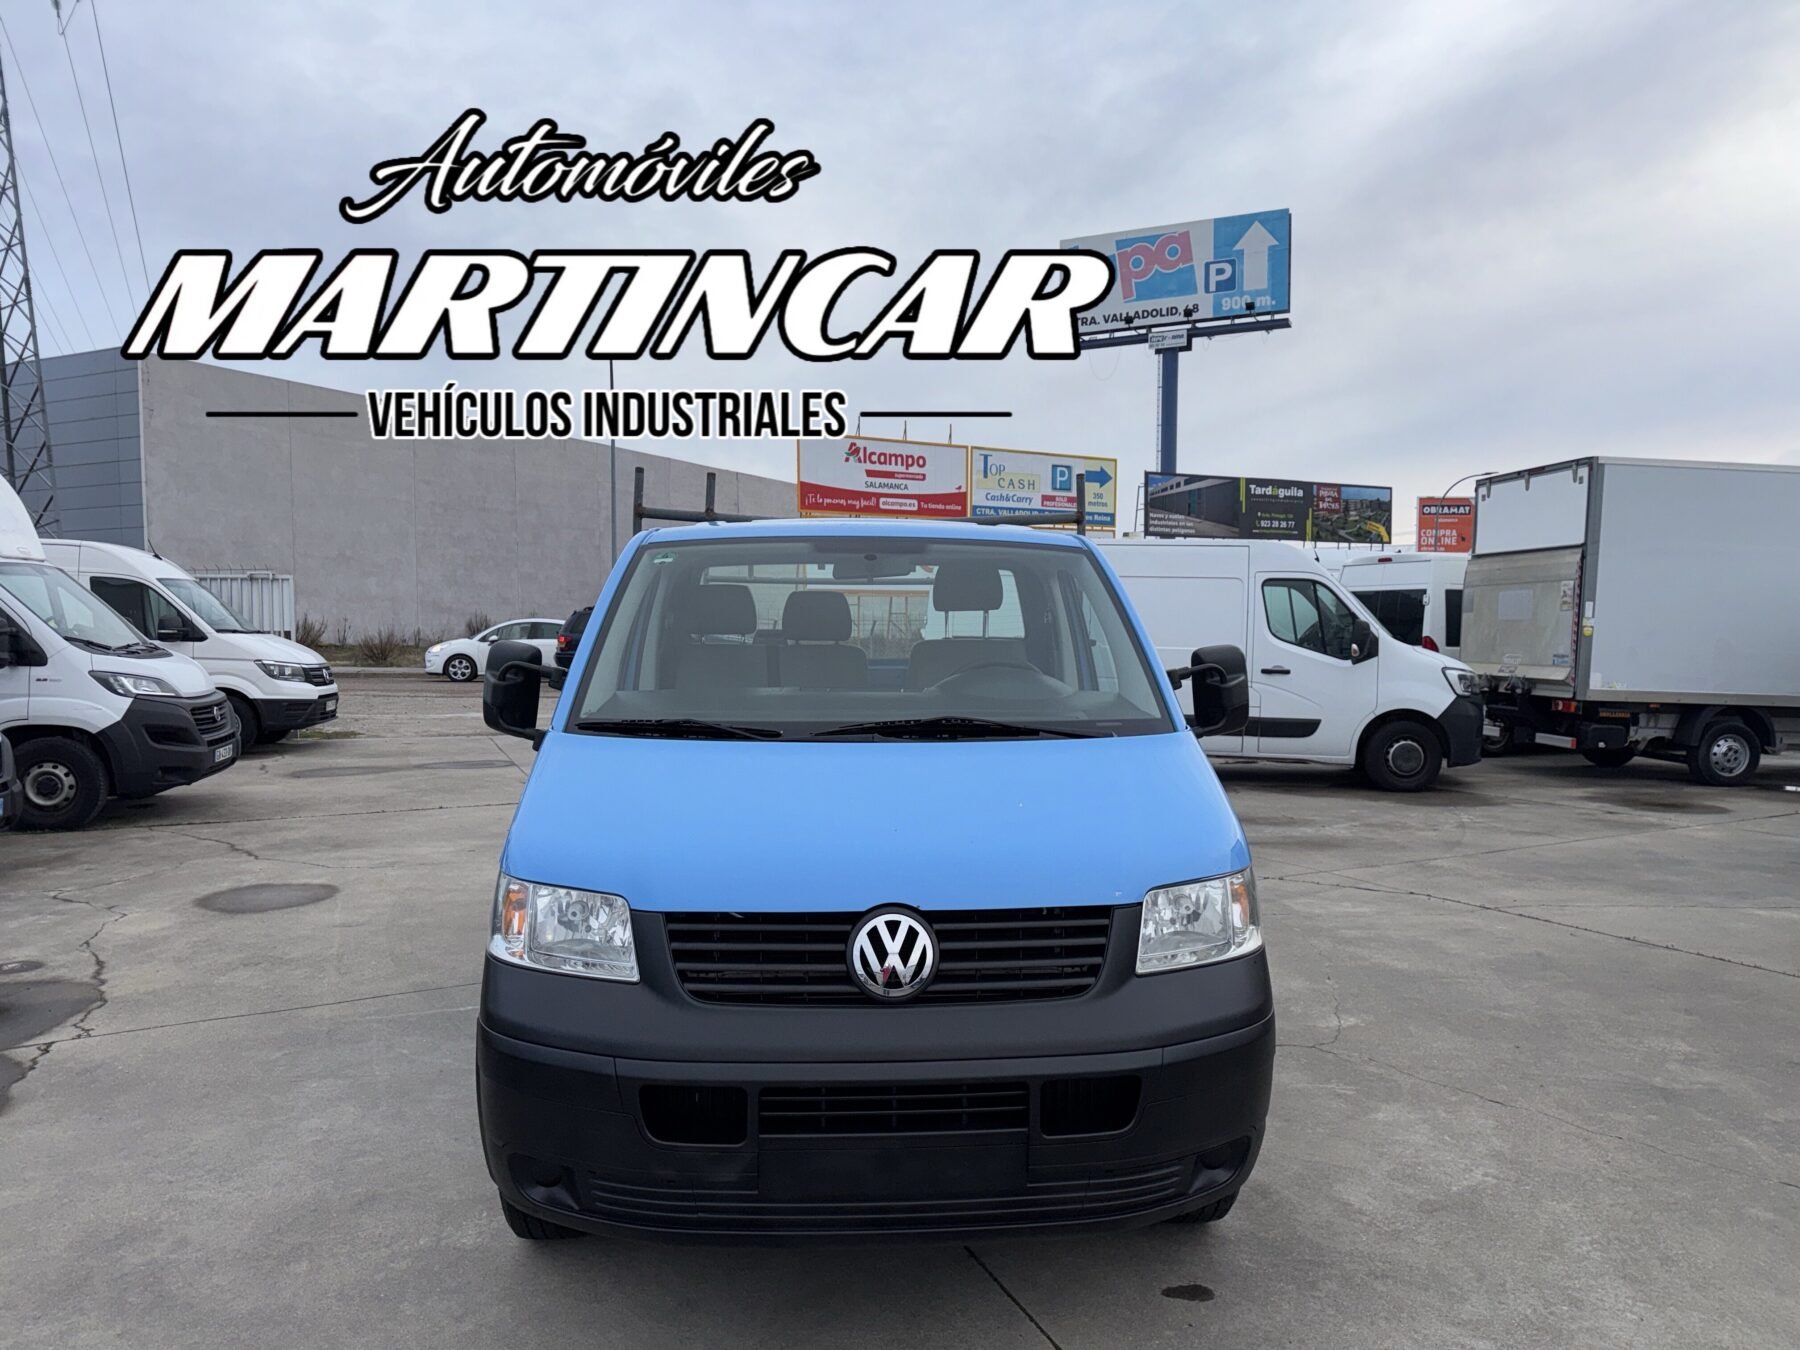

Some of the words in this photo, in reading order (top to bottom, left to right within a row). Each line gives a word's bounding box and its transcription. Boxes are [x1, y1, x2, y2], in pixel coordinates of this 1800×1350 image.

[845, 442, 927, 470] Alcampo
[864, 481, 909, 491] SALAMANCA
[998, 478, 1036, 490] CASH
[1249, 485, 1304, 498] Tardáguila
[881, 499, 916, 508] alcampo.es
[985, 492, 1034, 506] Cash&Carry
[1420, 536, 1457, 545] ONINE
